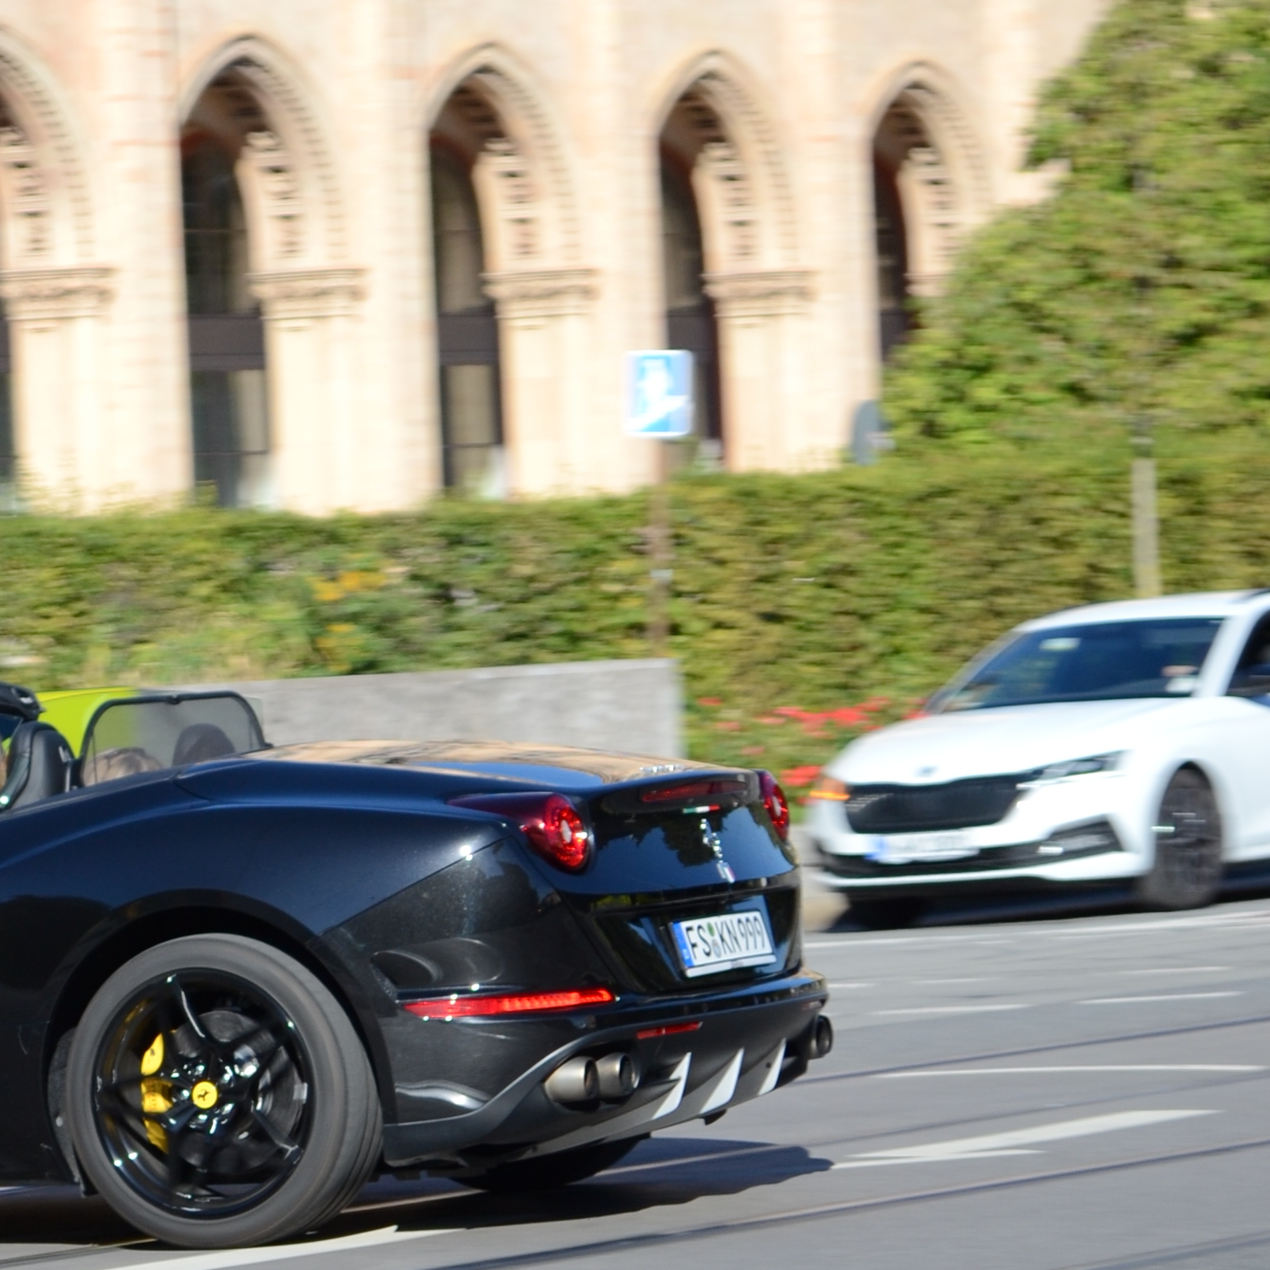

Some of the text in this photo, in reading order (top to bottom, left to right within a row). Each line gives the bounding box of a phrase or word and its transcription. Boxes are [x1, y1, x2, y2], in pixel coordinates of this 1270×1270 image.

[685, 915, 765, 960] FS KN 999
